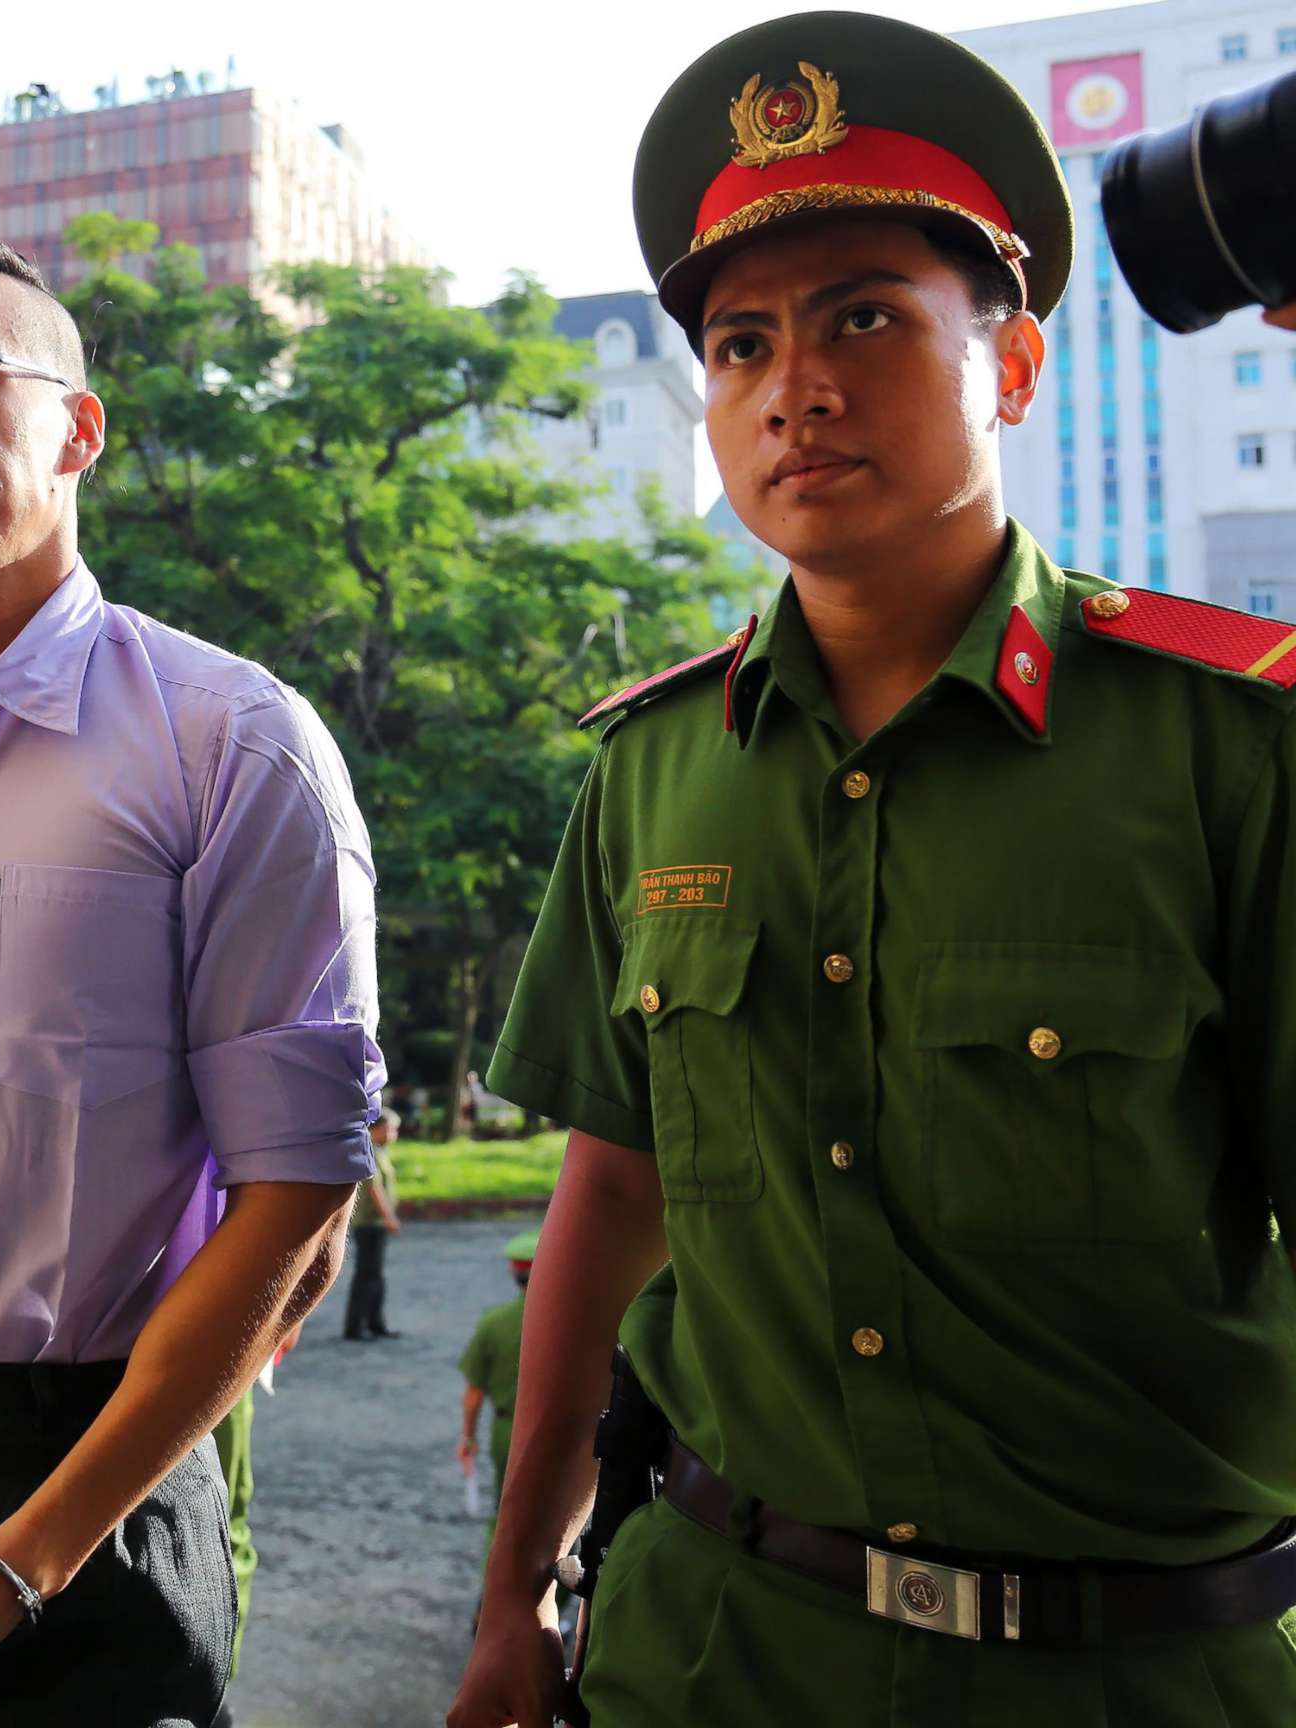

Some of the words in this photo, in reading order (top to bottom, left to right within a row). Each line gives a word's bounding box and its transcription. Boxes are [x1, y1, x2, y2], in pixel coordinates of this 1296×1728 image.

[662, 873, 694, 887] THANH
[646, 889, 667, 904] 297
[677, 887, 704, 901] 203
